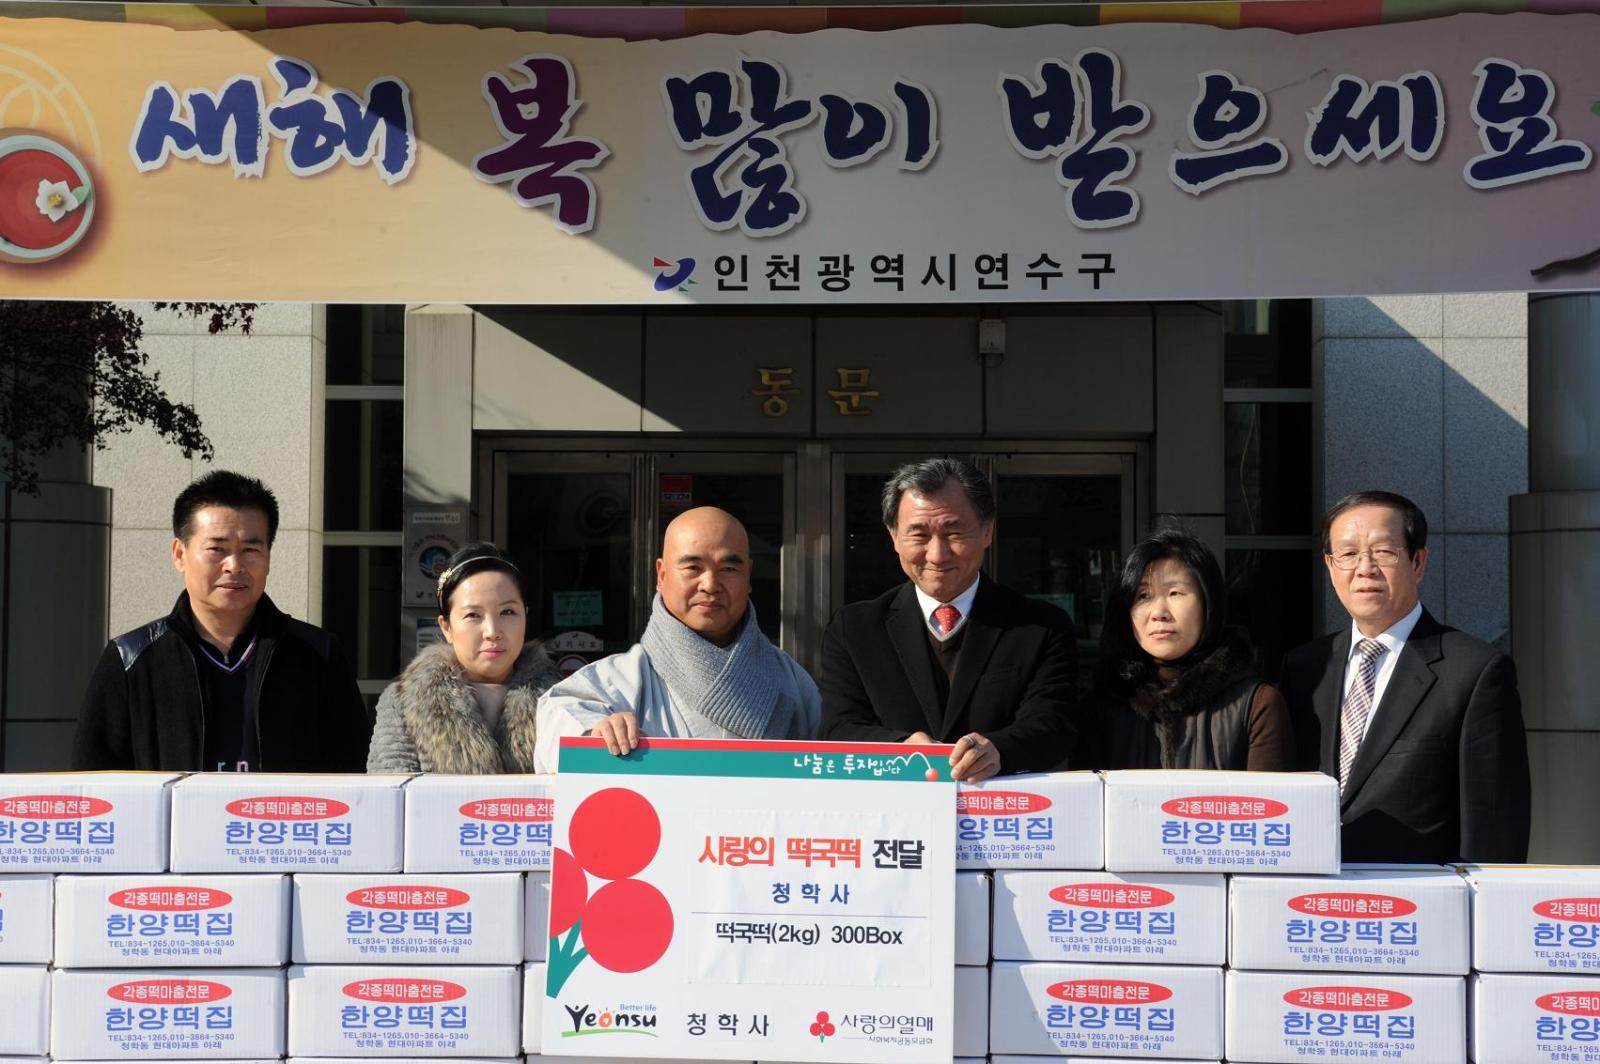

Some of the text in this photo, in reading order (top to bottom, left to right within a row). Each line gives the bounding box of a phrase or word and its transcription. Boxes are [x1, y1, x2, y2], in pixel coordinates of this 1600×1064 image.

[131, 51, 1587, 230] 새해 복 많이 받으세요
[794, 753, 901, 777] 나눔은 투자입니다
[225, 821, 352, 846] 한양떡집
[459, 823, 552, 847] 한양떡
[958, 816, 1053, 841] 양떡집
[1161, 821, 1291, 847] 한양떡집
[33, 855, 80, 863] 현대아파트
[84, 855, 102, 863] 아래
[697, 834, 925, 870] 사랑의 떡국떡 전달
[956, 844, 1056, 852] 4-1265,010-3664-5340
[1024, 852, 1043, 860] 아래
[271, 856, 317, 864] 현대아파트
[320, 856, 339, 865] 아래
[1208, 856, 1255, 865] 현대아파트
[1259, 857, 1278, 866] 아래
[771, 882, 851, 906] 청학사
[107, 913, 232, 938] 한양떡집
[346, 911, 472, 935] 한양떡집
[716, 921, 903, 946] 떡국떡(2kg) 300Box
[1047, 909, 1175, 935] 한양떡집
[1286, 919, 1417, 945] 한양떡집
[1533, 922, 1600, 948] 한양
[154, 947, 200, 956] 현대아파트
[203, 947, 222, 955] 아래
[391, 945, 437, 953] 현대아파트
[441, 945, 460, 953] 아래
[1095, 944, 1141, 954] 현대아파트
[1145, 946, 1164, 954] 아래
[1335, 955, 1382, 964] 현대아파트
[1386, 956, 1406, 965] 아래
[106, 1006, 232, 1032] 한양떡집
[341, 1005, 466, 1029] 한양떡집
[564, 1003, 657, 1033] Yeonsu
[619, 1003, 657, 1012] Better life
[1046, 1004, 1175, 1031] 한양떡집
[687, 1013, 770, 1037] 청학사
[840, 1014, 933, 1035] 사랑의열매
[1283, 1011, 1415, 1040] 한양떡집
[153, 1041, 200, 1050] 현대아파트
[203, 1041, 222, 1049] 아래
[388, 1039, 434, 1048] 현대아파트
[437, 1040, 457, 1048] 아래
[1092, 1040, 1139, 1050] 현대아파트
[1142, 1042, 1161, 1050] 아래
[1330, 1047, 1378, 1057] 현대아파트
[1382, 1049, 1402, 1058] 아래
